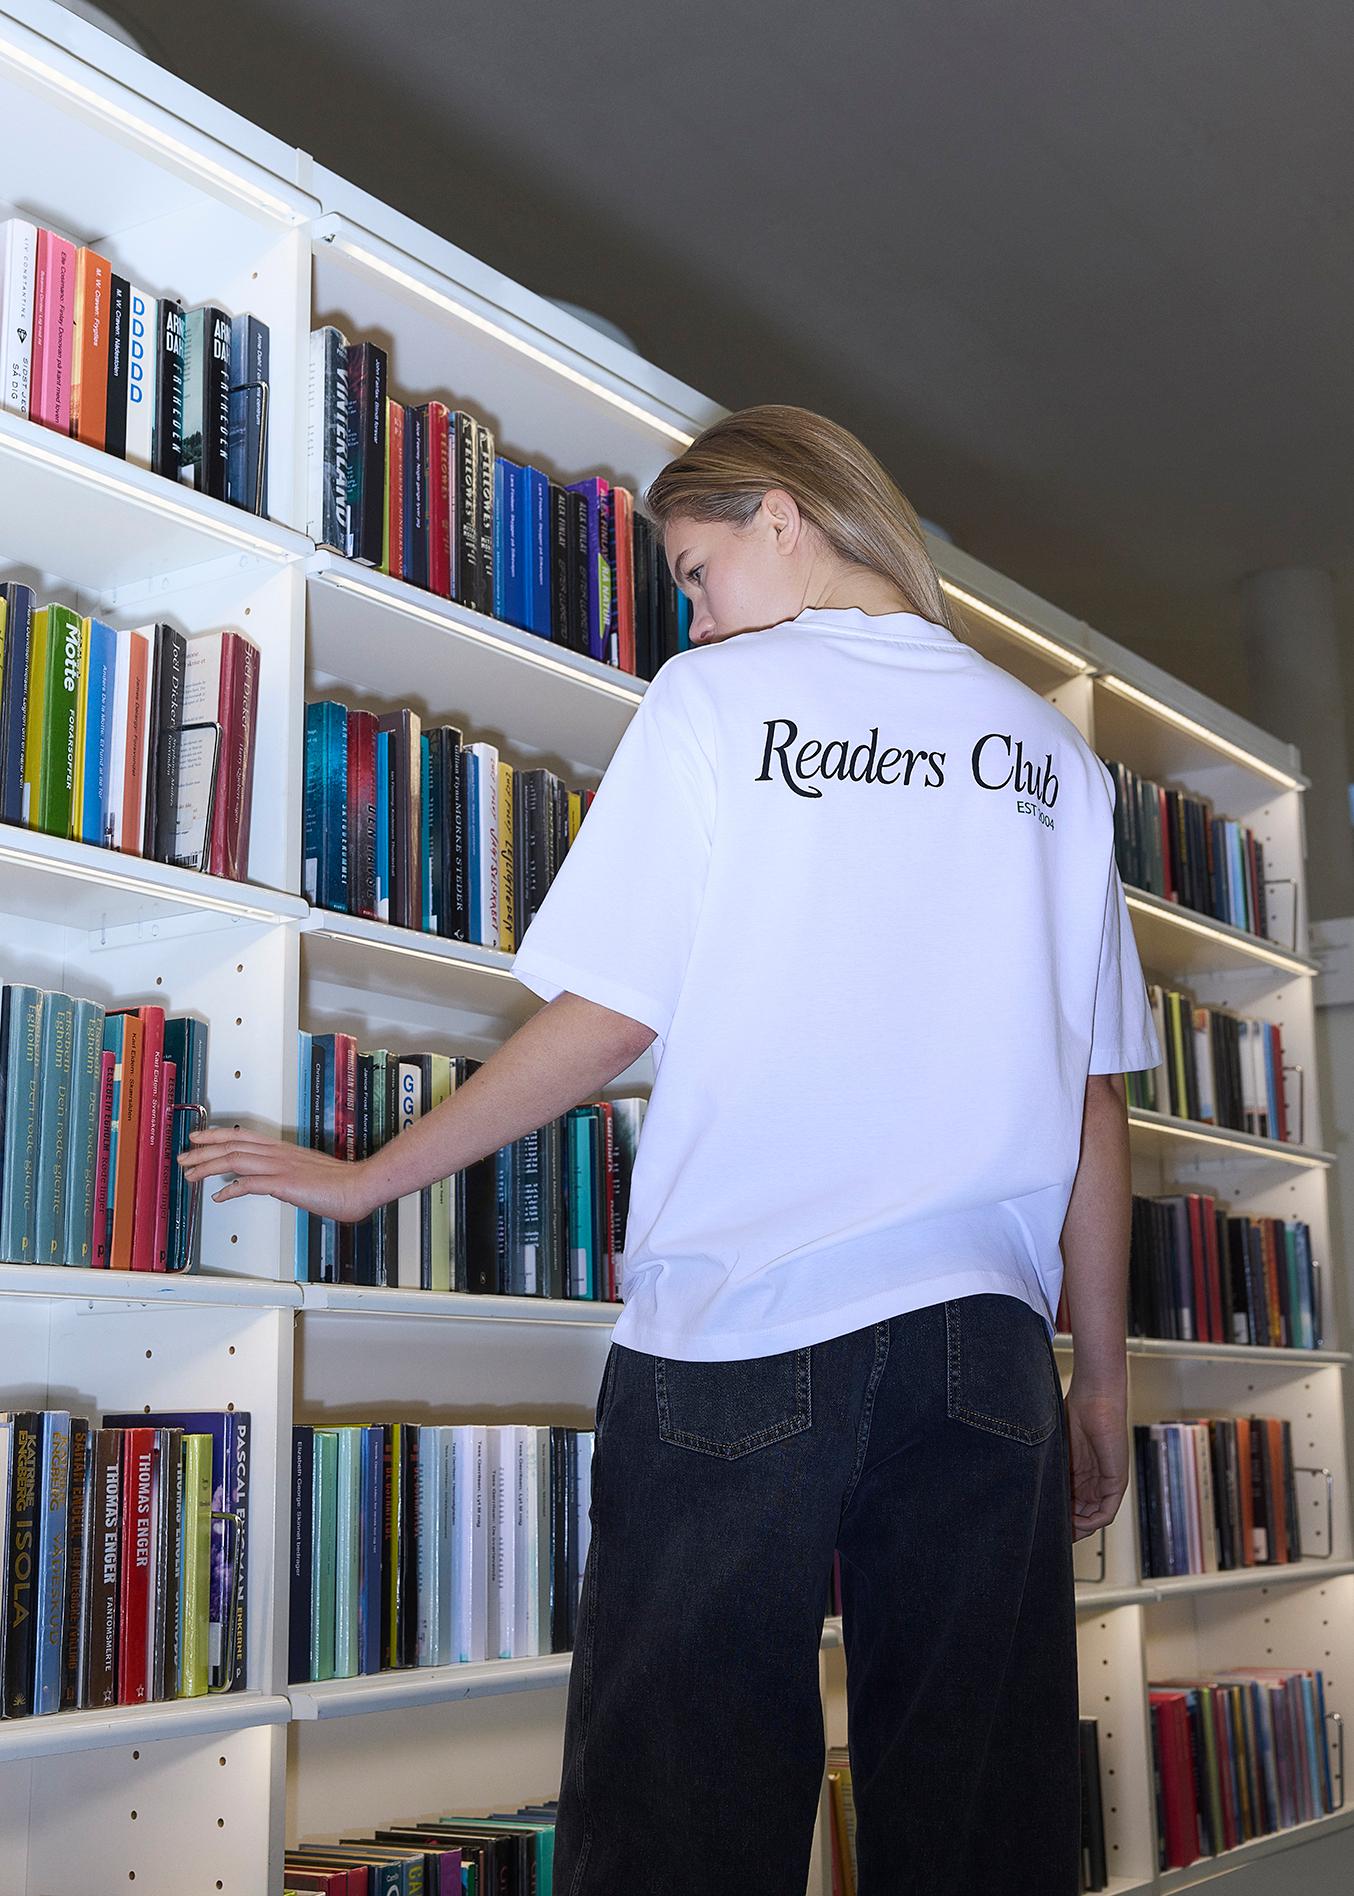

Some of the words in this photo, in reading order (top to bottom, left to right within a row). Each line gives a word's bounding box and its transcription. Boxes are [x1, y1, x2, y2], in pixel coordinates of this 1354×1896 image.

[20, 254, 28, 318] CONSTANTINE
[94, 267, 102, 278] M.
[94, 278, 102, 289] W.
[115, 288, 122, 298] M.
[115, 299, 122, 310] W.
[114, 310, 122, 338] Craven:
[166, 311, 184, 339] ARN
[213, 318, 231, 346] ARN
[112, 338, 121, 377] Nådestolen
[166, 331, 184, 359] DAH
[213, 338, 231, 366] DAH
[12, 363, 21, 377] SÅ
[55, 359, 62, 371] på
[171, 363, 183, 453] FRIHEDEN
[219, 369, 229, 461] FRIHEDEN
[334, 366, 349, 528] VINTERLAND
[440, 432, 448, 499] FELLOWES
[464, 438, 474, 516] FELLOWES
[481, 451, 492, 529] FELLOWES
[558, 494, 566, 518] ALEX
[579, 501, 587, 524] ALEX
[600, 488, 609, 516] ALEX
[558, 519, 566, 548] FINLAY
[579, 525, 587, 554] FINLAY
[600, 520, 610, 562] FINLAY
[602, 586, 611, 627] NATUR
[63, 622, 80, 692] Motte
[171, 641, 180, 671] Joël
[244, 647, 254, 678] Joël
[170, 676, 180, 726] Dicker
[241, 681, 252, 731] Dicker
[169, 738, 177, 776] Stephanie
[754, 718, 946, 798] Readers
[971, 733, 1059, 808] Club
[367, 804, 376, 839] DEN
[1016, 800, 1037, 816] EST
[456, 857, 464, 912] STEDER
[26, 1004, 36, 1062] Egholm
[55, 1011, 65, 1068] Egholm
[63, 1010, 73, 1073] Elsebeth
[87, 1018, 96, 1075] Egholm
[130, 1033, 138, 1048] Karl
[153, 1051, 161, 1068] Karl
[347, 1049, 355, 1087] CHRISTIAN
[29, 1080, 38, 1111] Den
[57, 1085, 66, 1115] Den
[105, 1067, 115, 1112] ELSEBETH
[152, 1069, 161, 1097] Eidem:
[165, 1077, 175, 1123] ELSEBETH
[347, 1089, 355, 1111] FROST
[88, 1091, 96, 1122] Den
[149, 1099, 159, 1146] Svenskeren
[27, 1117, 36, 1154] røde
[55, 1121, 64, 1160] røde
[86, 1126, 95, 1165] røde
[103, 1115, 113, 1152] EGHOLM
[164, 1123, 174, 1160] EGHOLM
[23, 1160, 34, 1210] glente
[53, 1165, 63, 1214] glente
[100, 1156, 110, 1185] Røde
[162, 1165, 171, 1191] Røde
[84, 1168, 93, 1217] glente
[97, 1187, 107, 1215] linjer
[160, 1194, 169, 1221] linjer
[16, 1430, 28, 1512] ENGBERG
[26, 1433, 37, 1506] KATRINE
[50, 1431, 61, 1512] ENGBERG
[72, 1433, 87, 1482] SARAH
[235, 1425, 247, 1503] PASCAL
[105, 1463, 119, 1528] THOMAS
[138, 1453, 151, 1513] THOMAS
[295, 1478, 303, 1508] George:
[70, 1547, 81, 1567] DEN
[103, 1533, 117, 1584] ENGER
[136, 1518, 150, 1567] ENGER
[294, 1540, 302, 1577] bedrager
[12, 1519, 34, 1628] ISOLA
[104, 1597, 114, 1672] FANTOMSMERTE
[235, 1606, 244, 1660] ENKERNE
